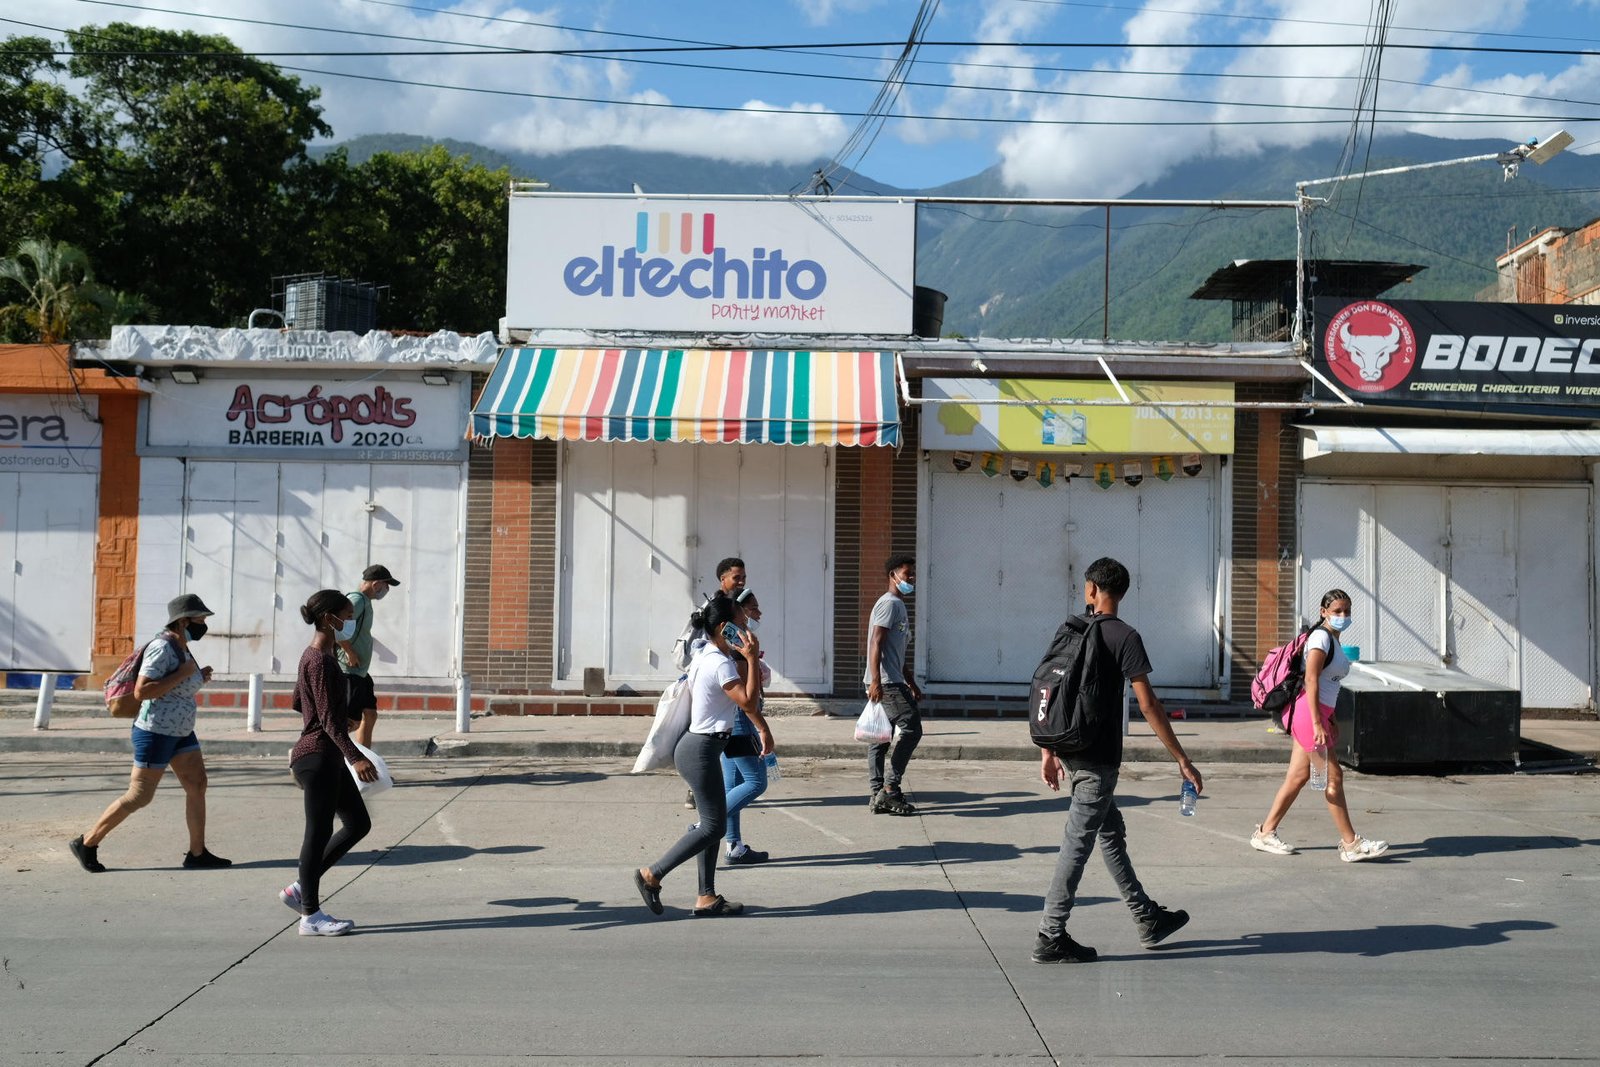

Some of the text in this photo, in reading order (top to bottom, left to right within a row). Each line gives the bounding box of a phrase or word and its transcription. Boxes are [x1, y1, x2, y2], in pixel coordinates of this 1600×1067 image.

[711, 303, 826, 321] party market
[1351, 304, 1370, 314] DON
[1371, 304, 1404, 327] FRANCO
[1409, 382, 1477, 392] CARNICERIA
[1481, 384, 1560, 394] CHARCUTERIA
[0, 414, 69, 442] era
[228, 430, 324, 446] BARBERIA
[351, 432, 404, 447] 2020
[1037, 688, 1047, 721] FILA
